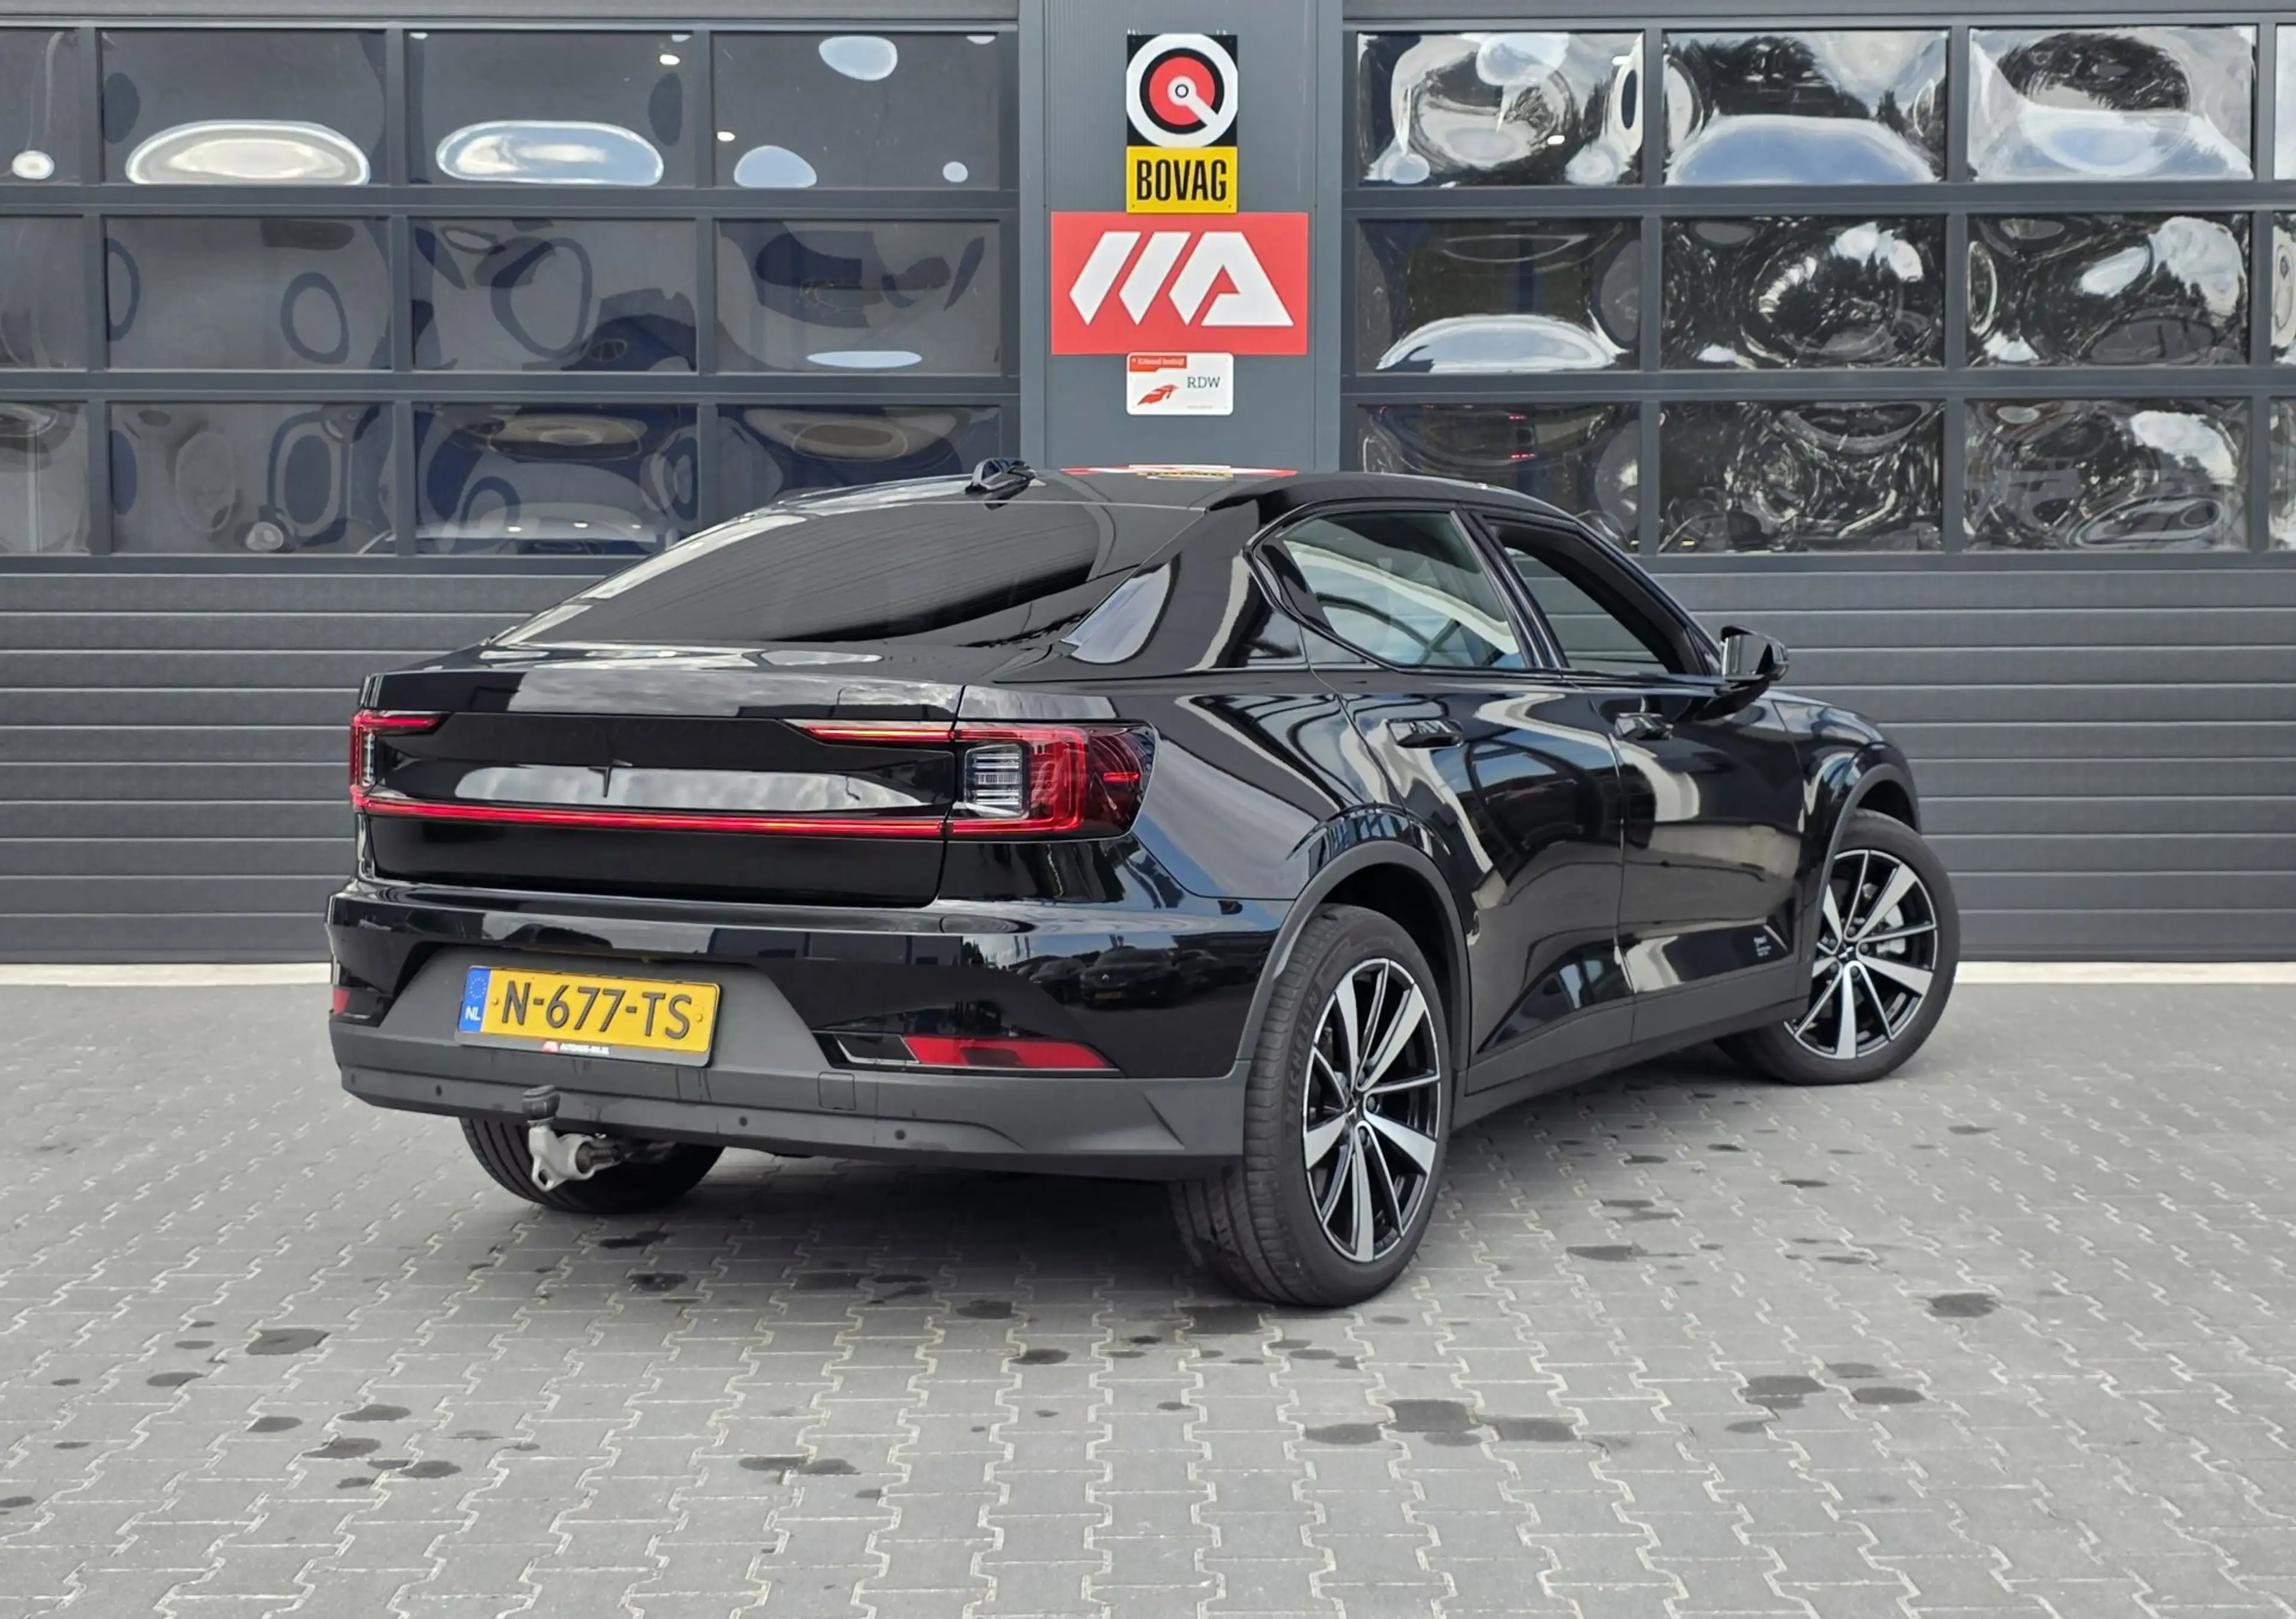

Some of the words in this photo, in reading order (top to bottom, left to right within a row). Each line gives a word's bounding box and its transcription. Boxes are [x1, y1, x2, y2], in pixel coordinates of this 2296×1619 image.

[1137, 159, 1227, 202] BOVAG
[1187, 376, 1221, 389] RDW
[465, 1006, 481, 1022] NL
[502, 981, 692, 1039] N-677-TS
